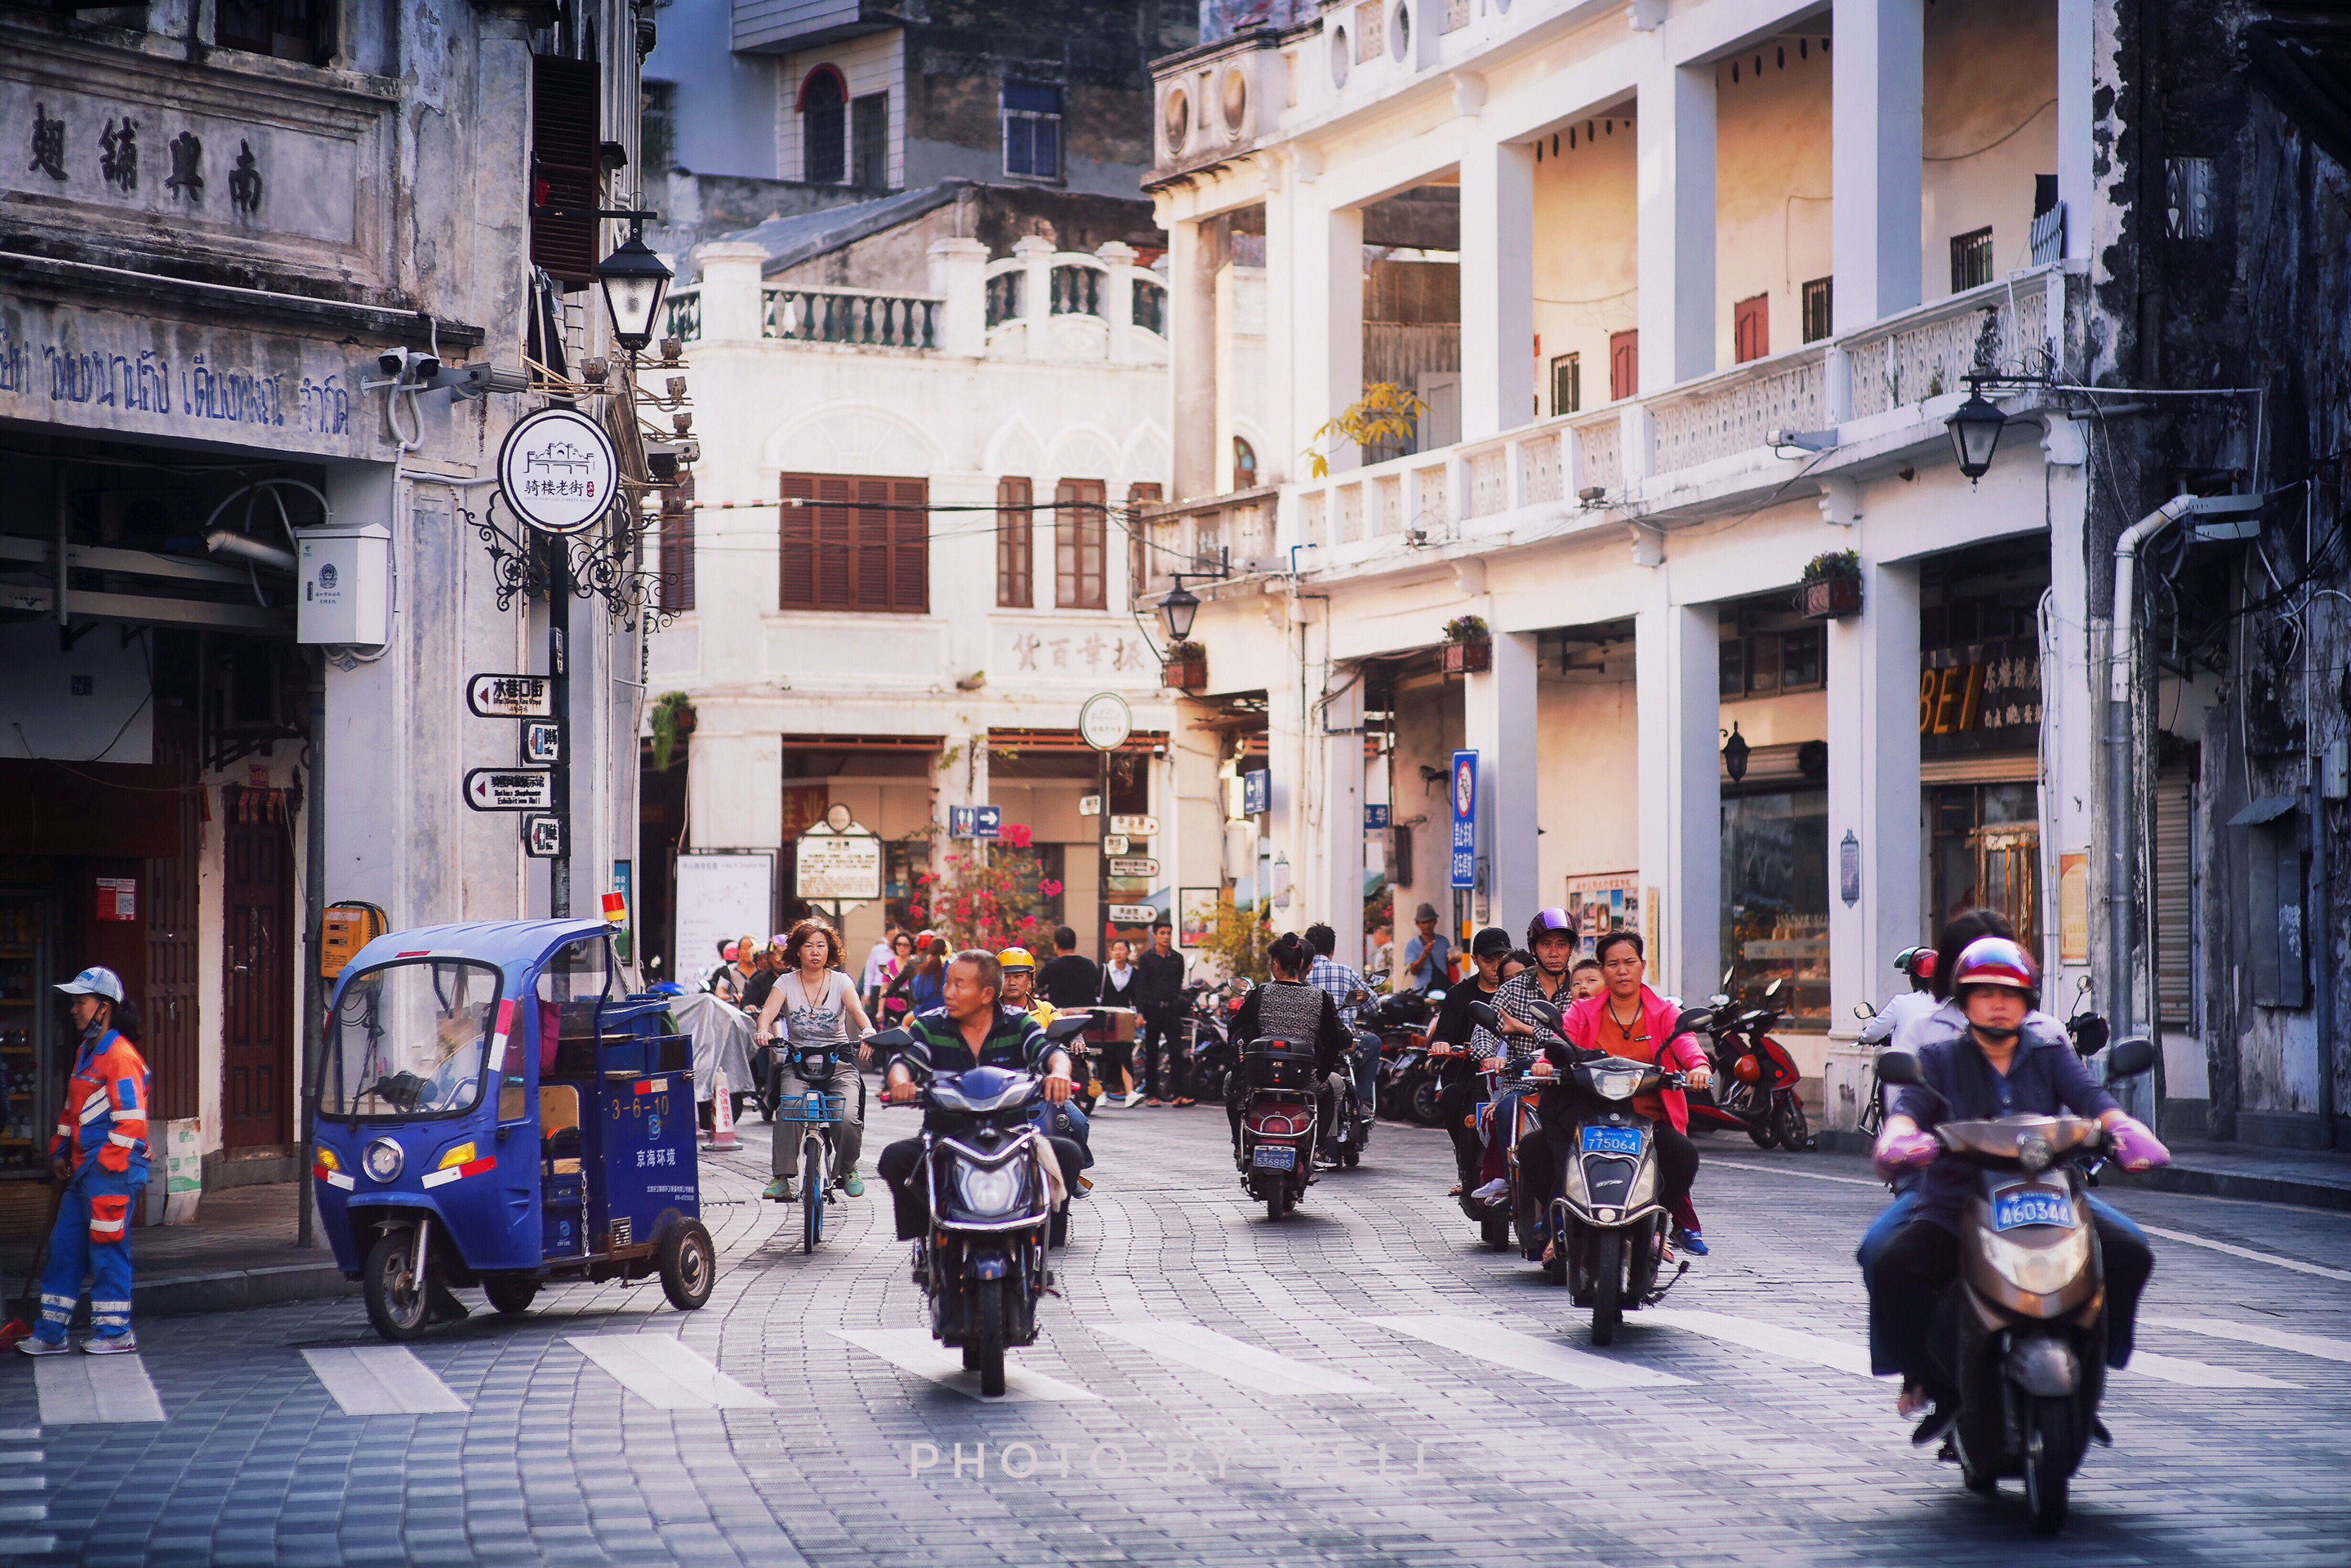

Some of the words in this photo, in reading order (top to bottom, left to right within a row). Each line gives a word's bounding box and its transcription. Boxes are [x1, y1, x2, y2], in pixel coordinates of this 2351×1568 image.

[524, 479, 584, 497] 骑楼老街
[492, 679, 544, 697] 水巷口街
[612, 1095, 670, 1120] 3-6-10
[1587, 1138, 1637, 1152] 775064
[636, 1148, 676, 1168] 京海环境
[1256, 1156, 1292, 1169] 536885
[2001, 1202, 2071, 1225] 460344
